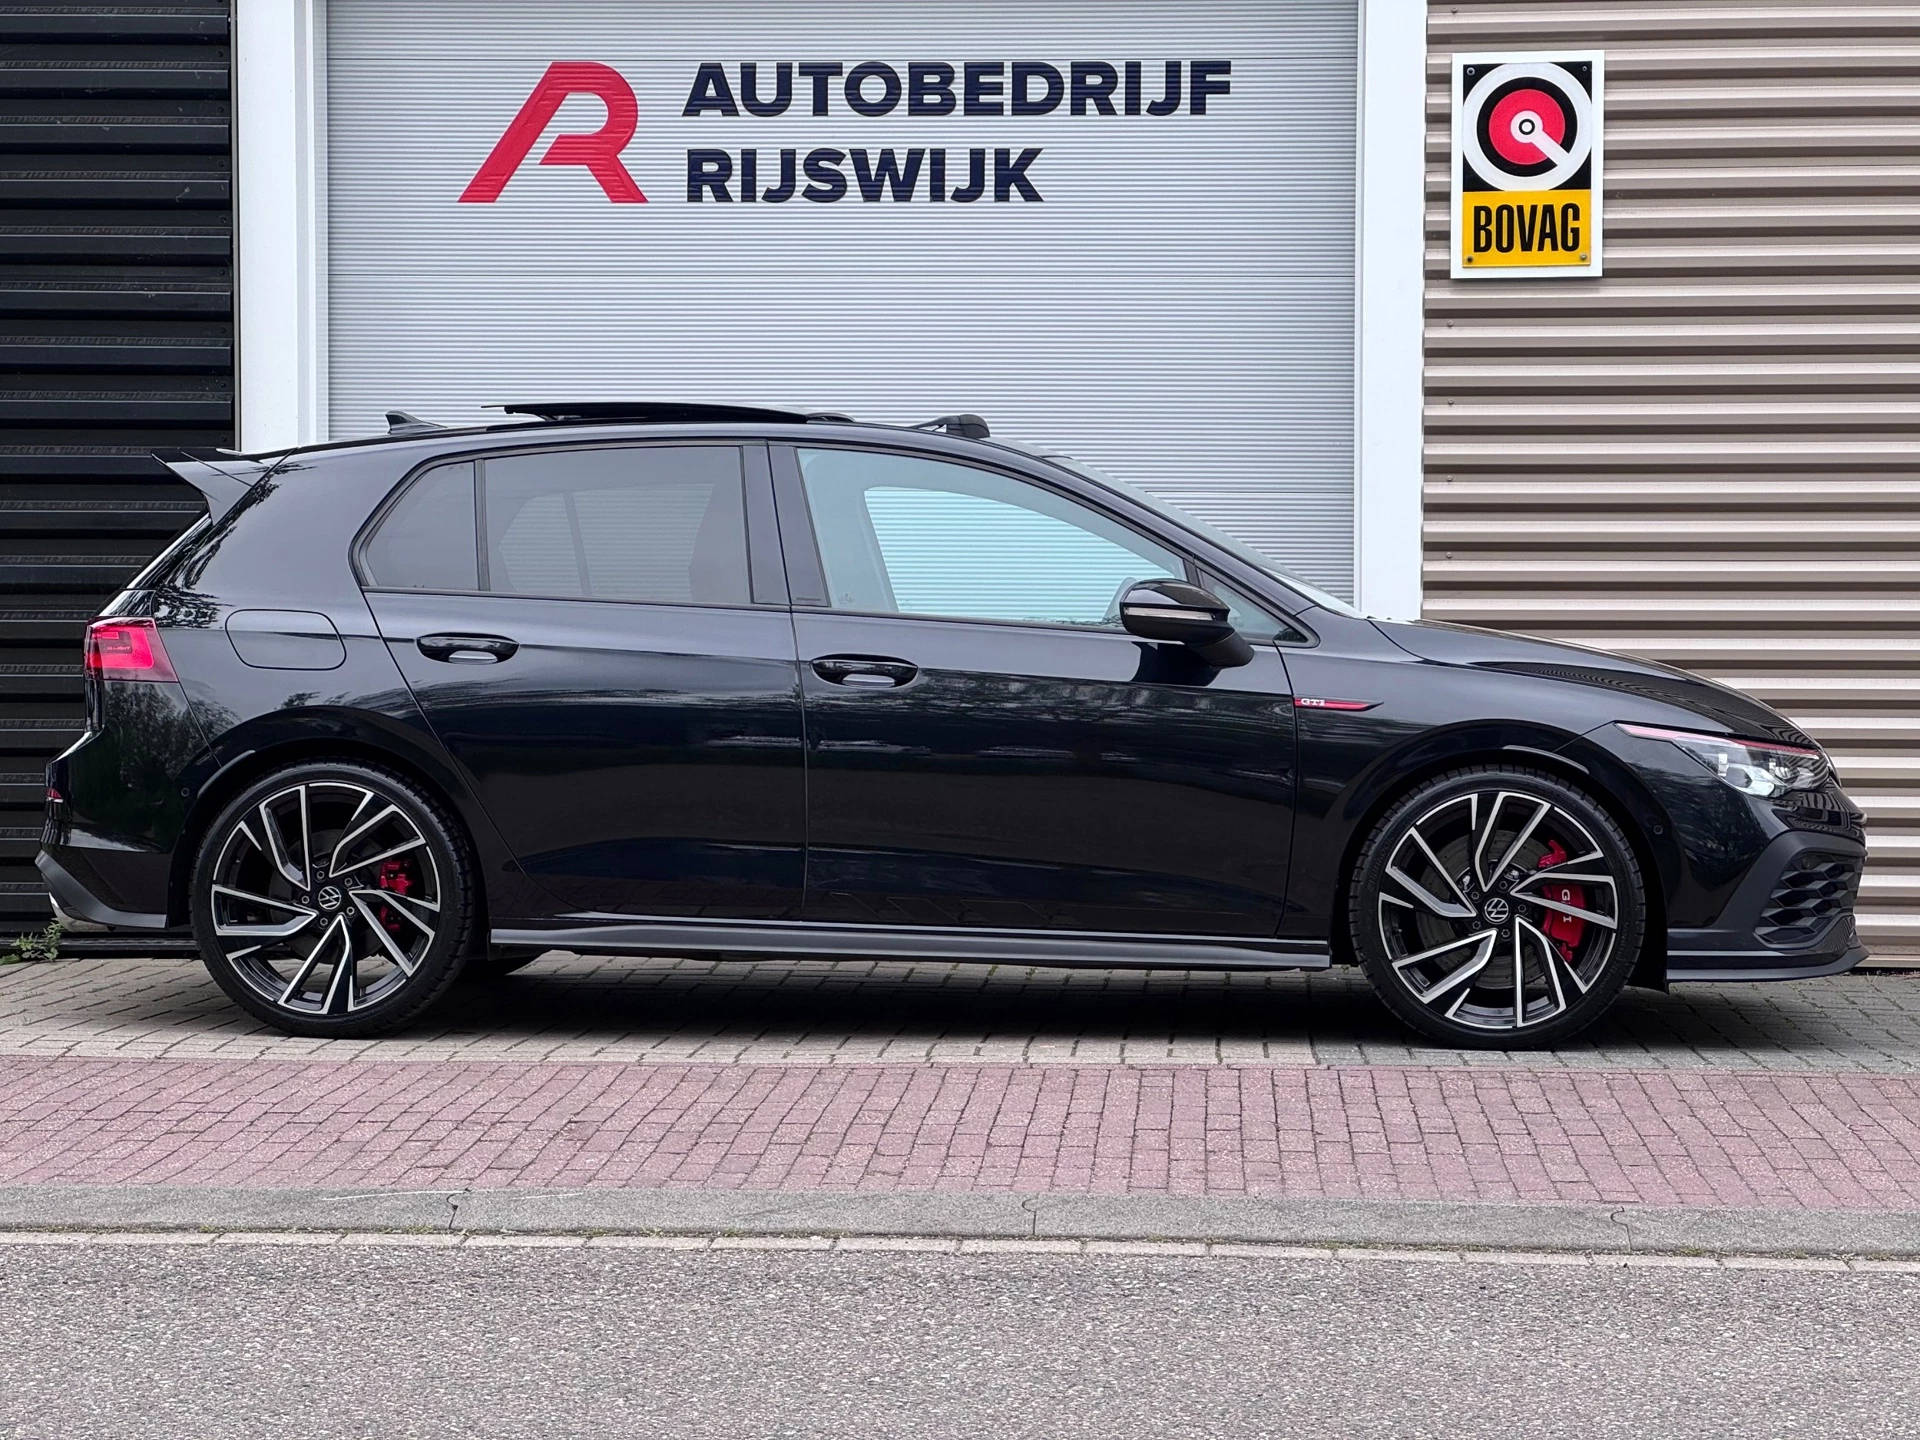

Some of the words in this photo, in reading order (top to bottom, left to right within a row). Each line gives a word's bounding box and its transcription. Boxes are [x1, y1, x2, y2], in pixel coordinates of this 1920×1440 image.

[683, 61, 1232, 117] AUTOBEDRIJF
[687, 148, 1044, 203] RIJSWIJK
[1473, 202, 1581, 253] BOVAG
[1301, 698, 1325, 706] GTI
[1561, 888, 1572, 923] GI
